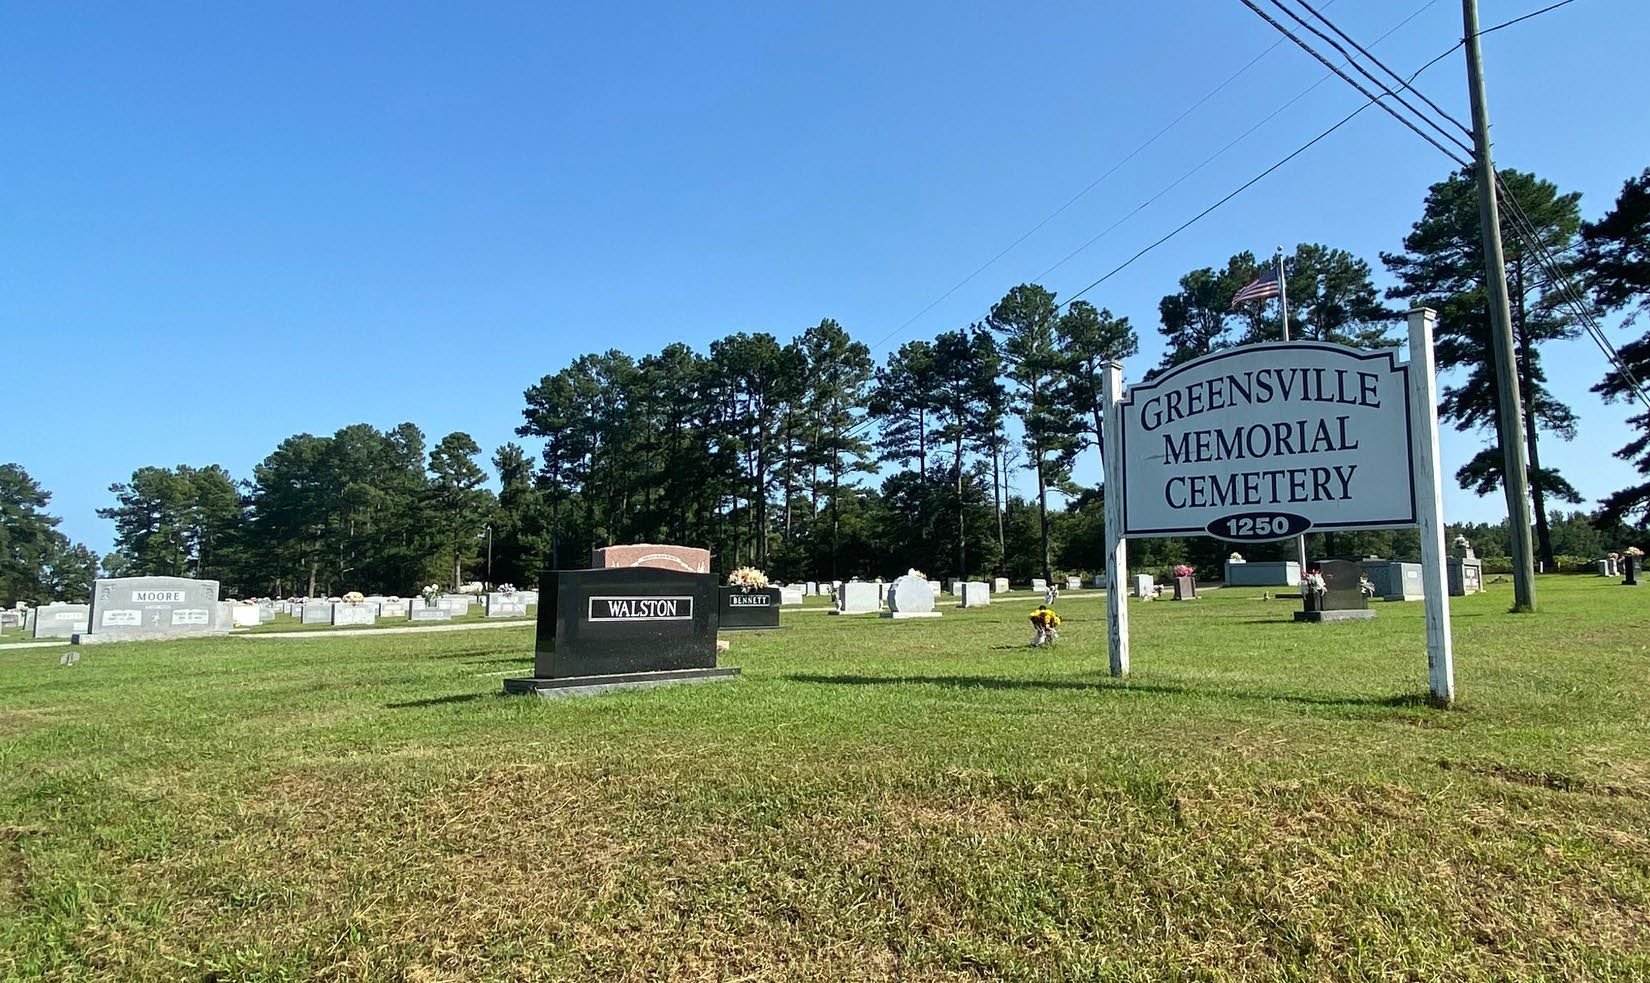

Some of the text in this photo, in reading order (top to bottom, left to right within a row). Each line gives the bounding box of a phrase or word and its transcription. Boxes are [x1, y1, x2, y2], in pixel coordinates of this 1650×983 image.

[1140, 367, 1381, 432] GREENSVILLE
[1162, 416, 1359, 465] MEMORIAL
[1164, 464, 1358, 509] CEMETERY
[1226, 516, 1290, 536] 1250
[137, 592, 180, 601] MOORE
[732, 596, 767, 605] BENNETT
[607, 600, 678, 617] WALSTON
